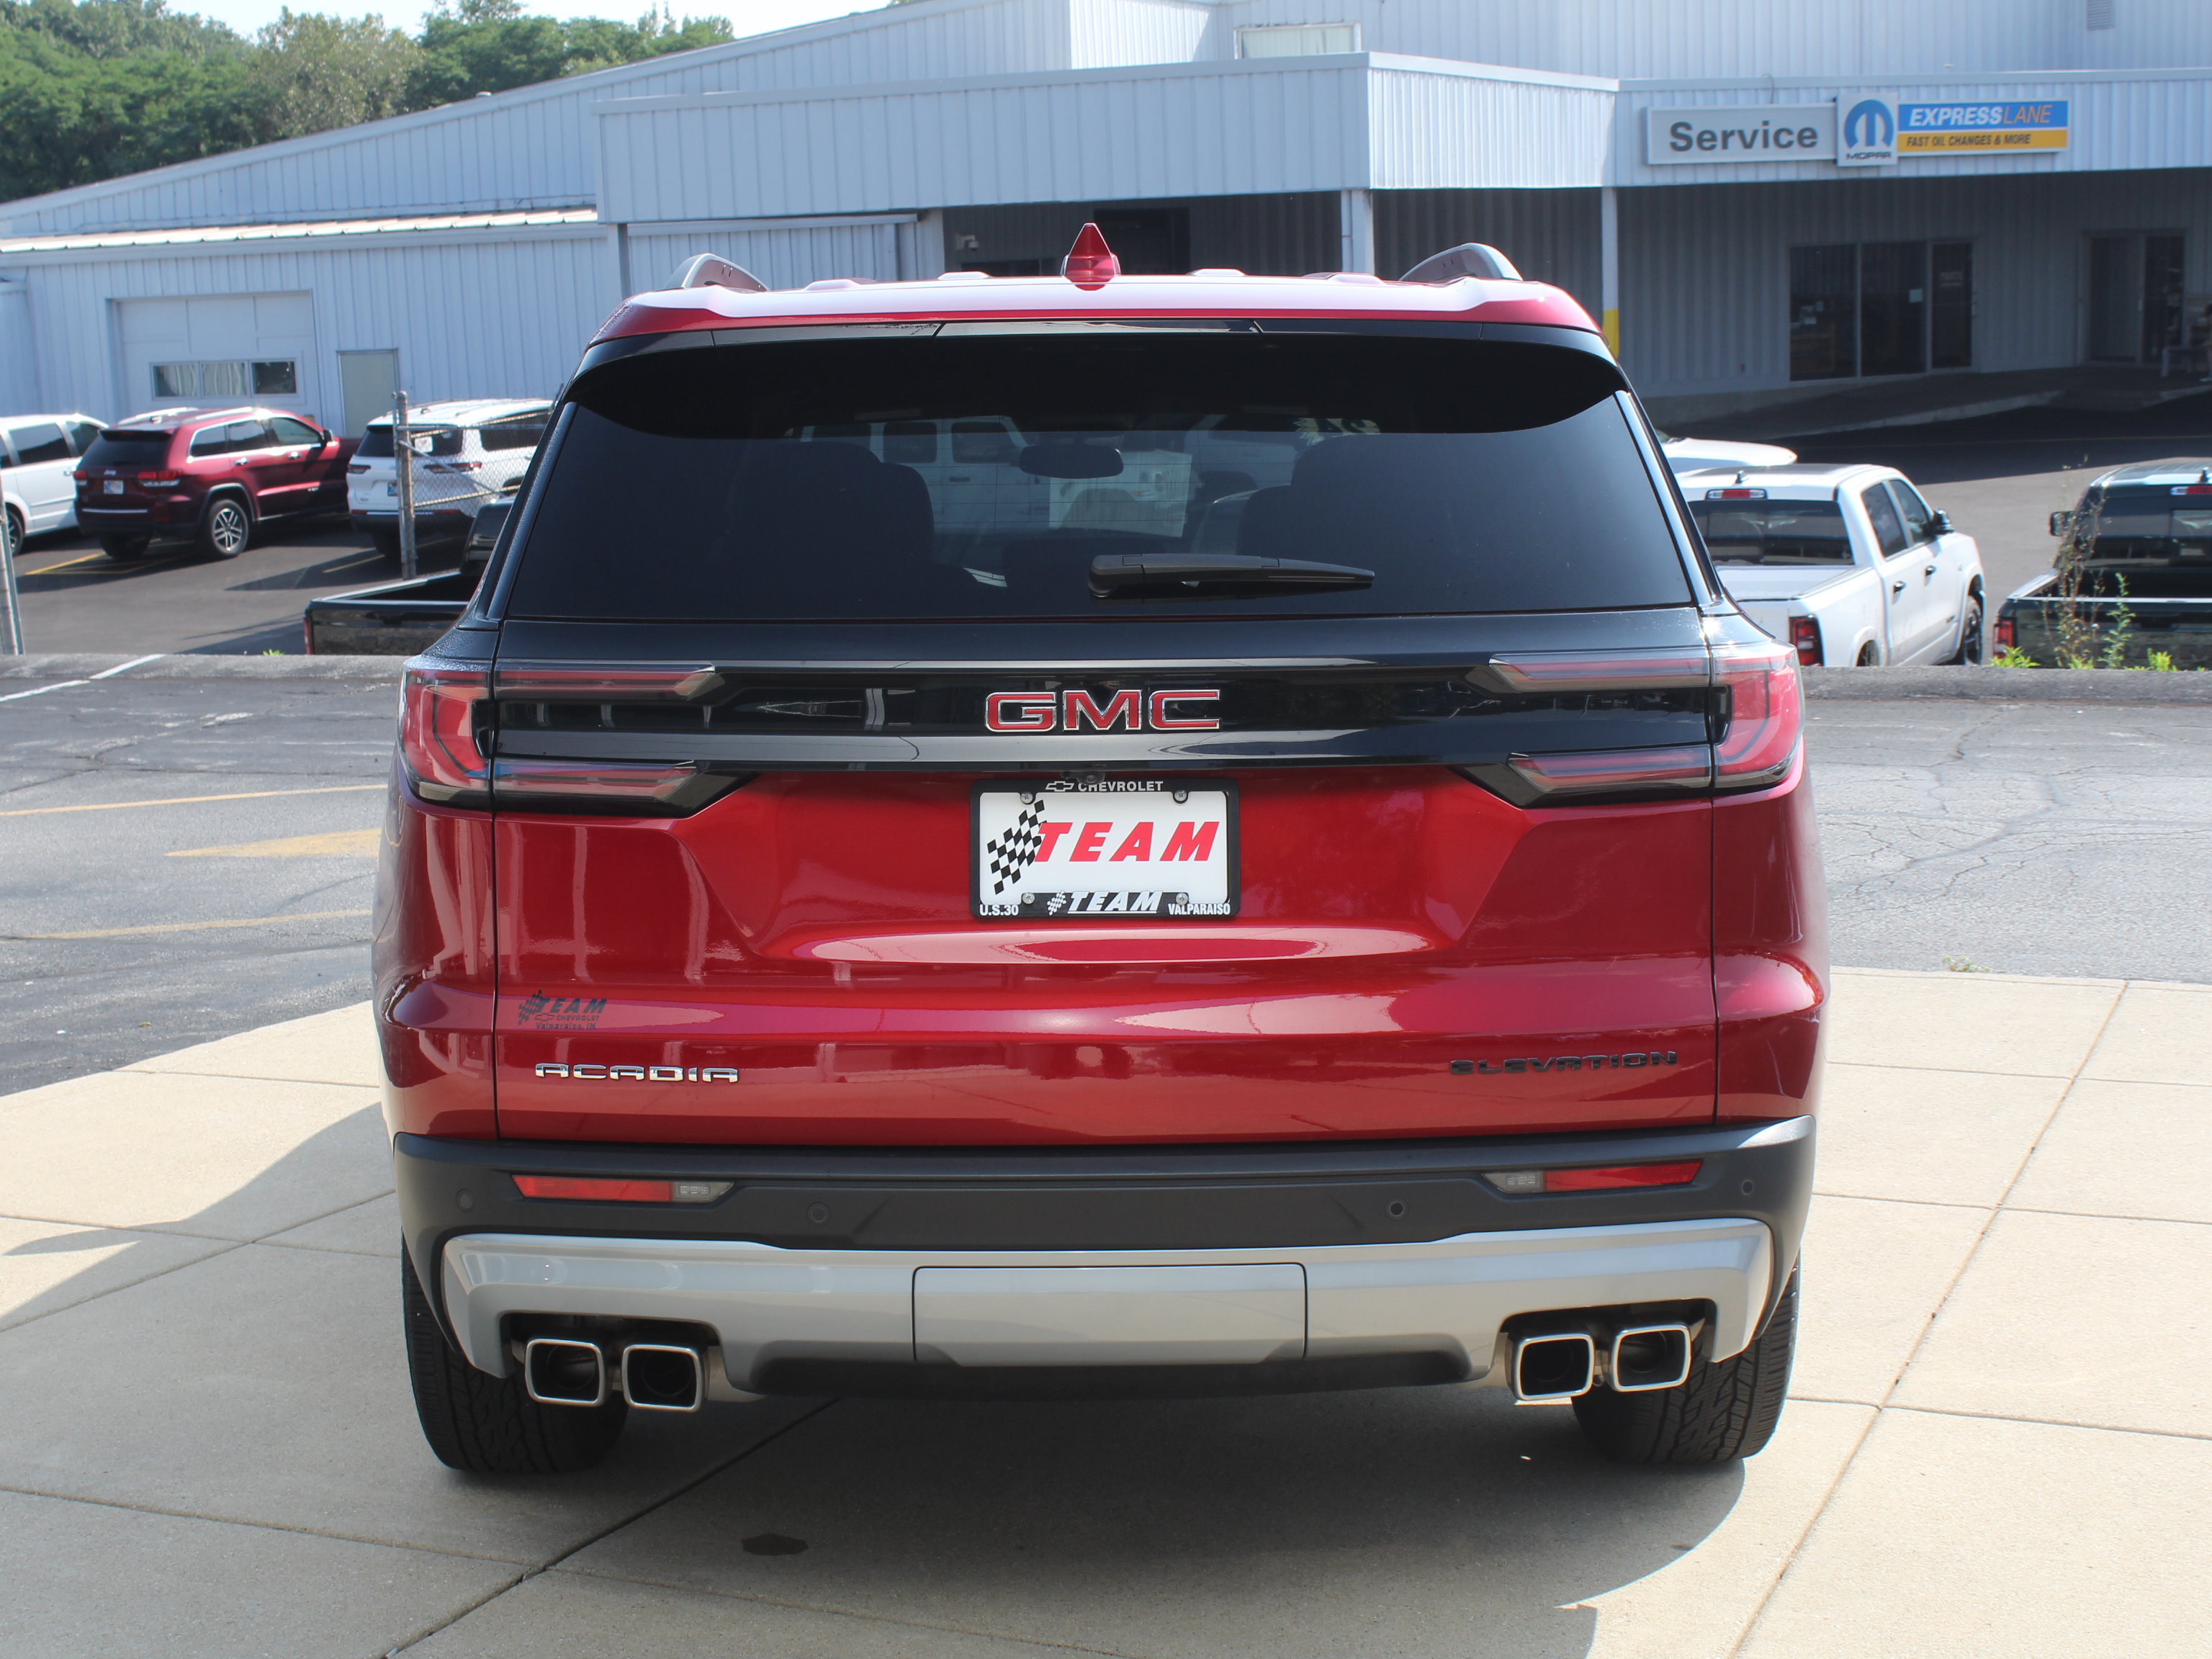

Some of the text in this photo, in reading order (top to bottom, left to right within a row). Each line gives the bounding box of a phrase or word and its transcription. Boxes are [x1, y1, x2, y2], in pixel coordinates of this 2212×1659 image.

[1669, 120, 1818, 151] Service
[1907, 132, 2031, 147] FAST OIL CHANGES & MORE
[1845, 151, 1892, 160] MOPAR
[986, 689, 1220, 732] GMC
[1078, 781, 1164, 792] CHEVROLET
[1034, 822, 1220, 862] TEAM
[1069, 891, 1163, 912] TEAM
[1168, 902, 1231, 915] VALPARAISO
[536, 998, 607, 1013] TEAM
[1449, 1051, 1677, 1074] ELEVATION
[535, 1063, 739, 1083] ACADIA
